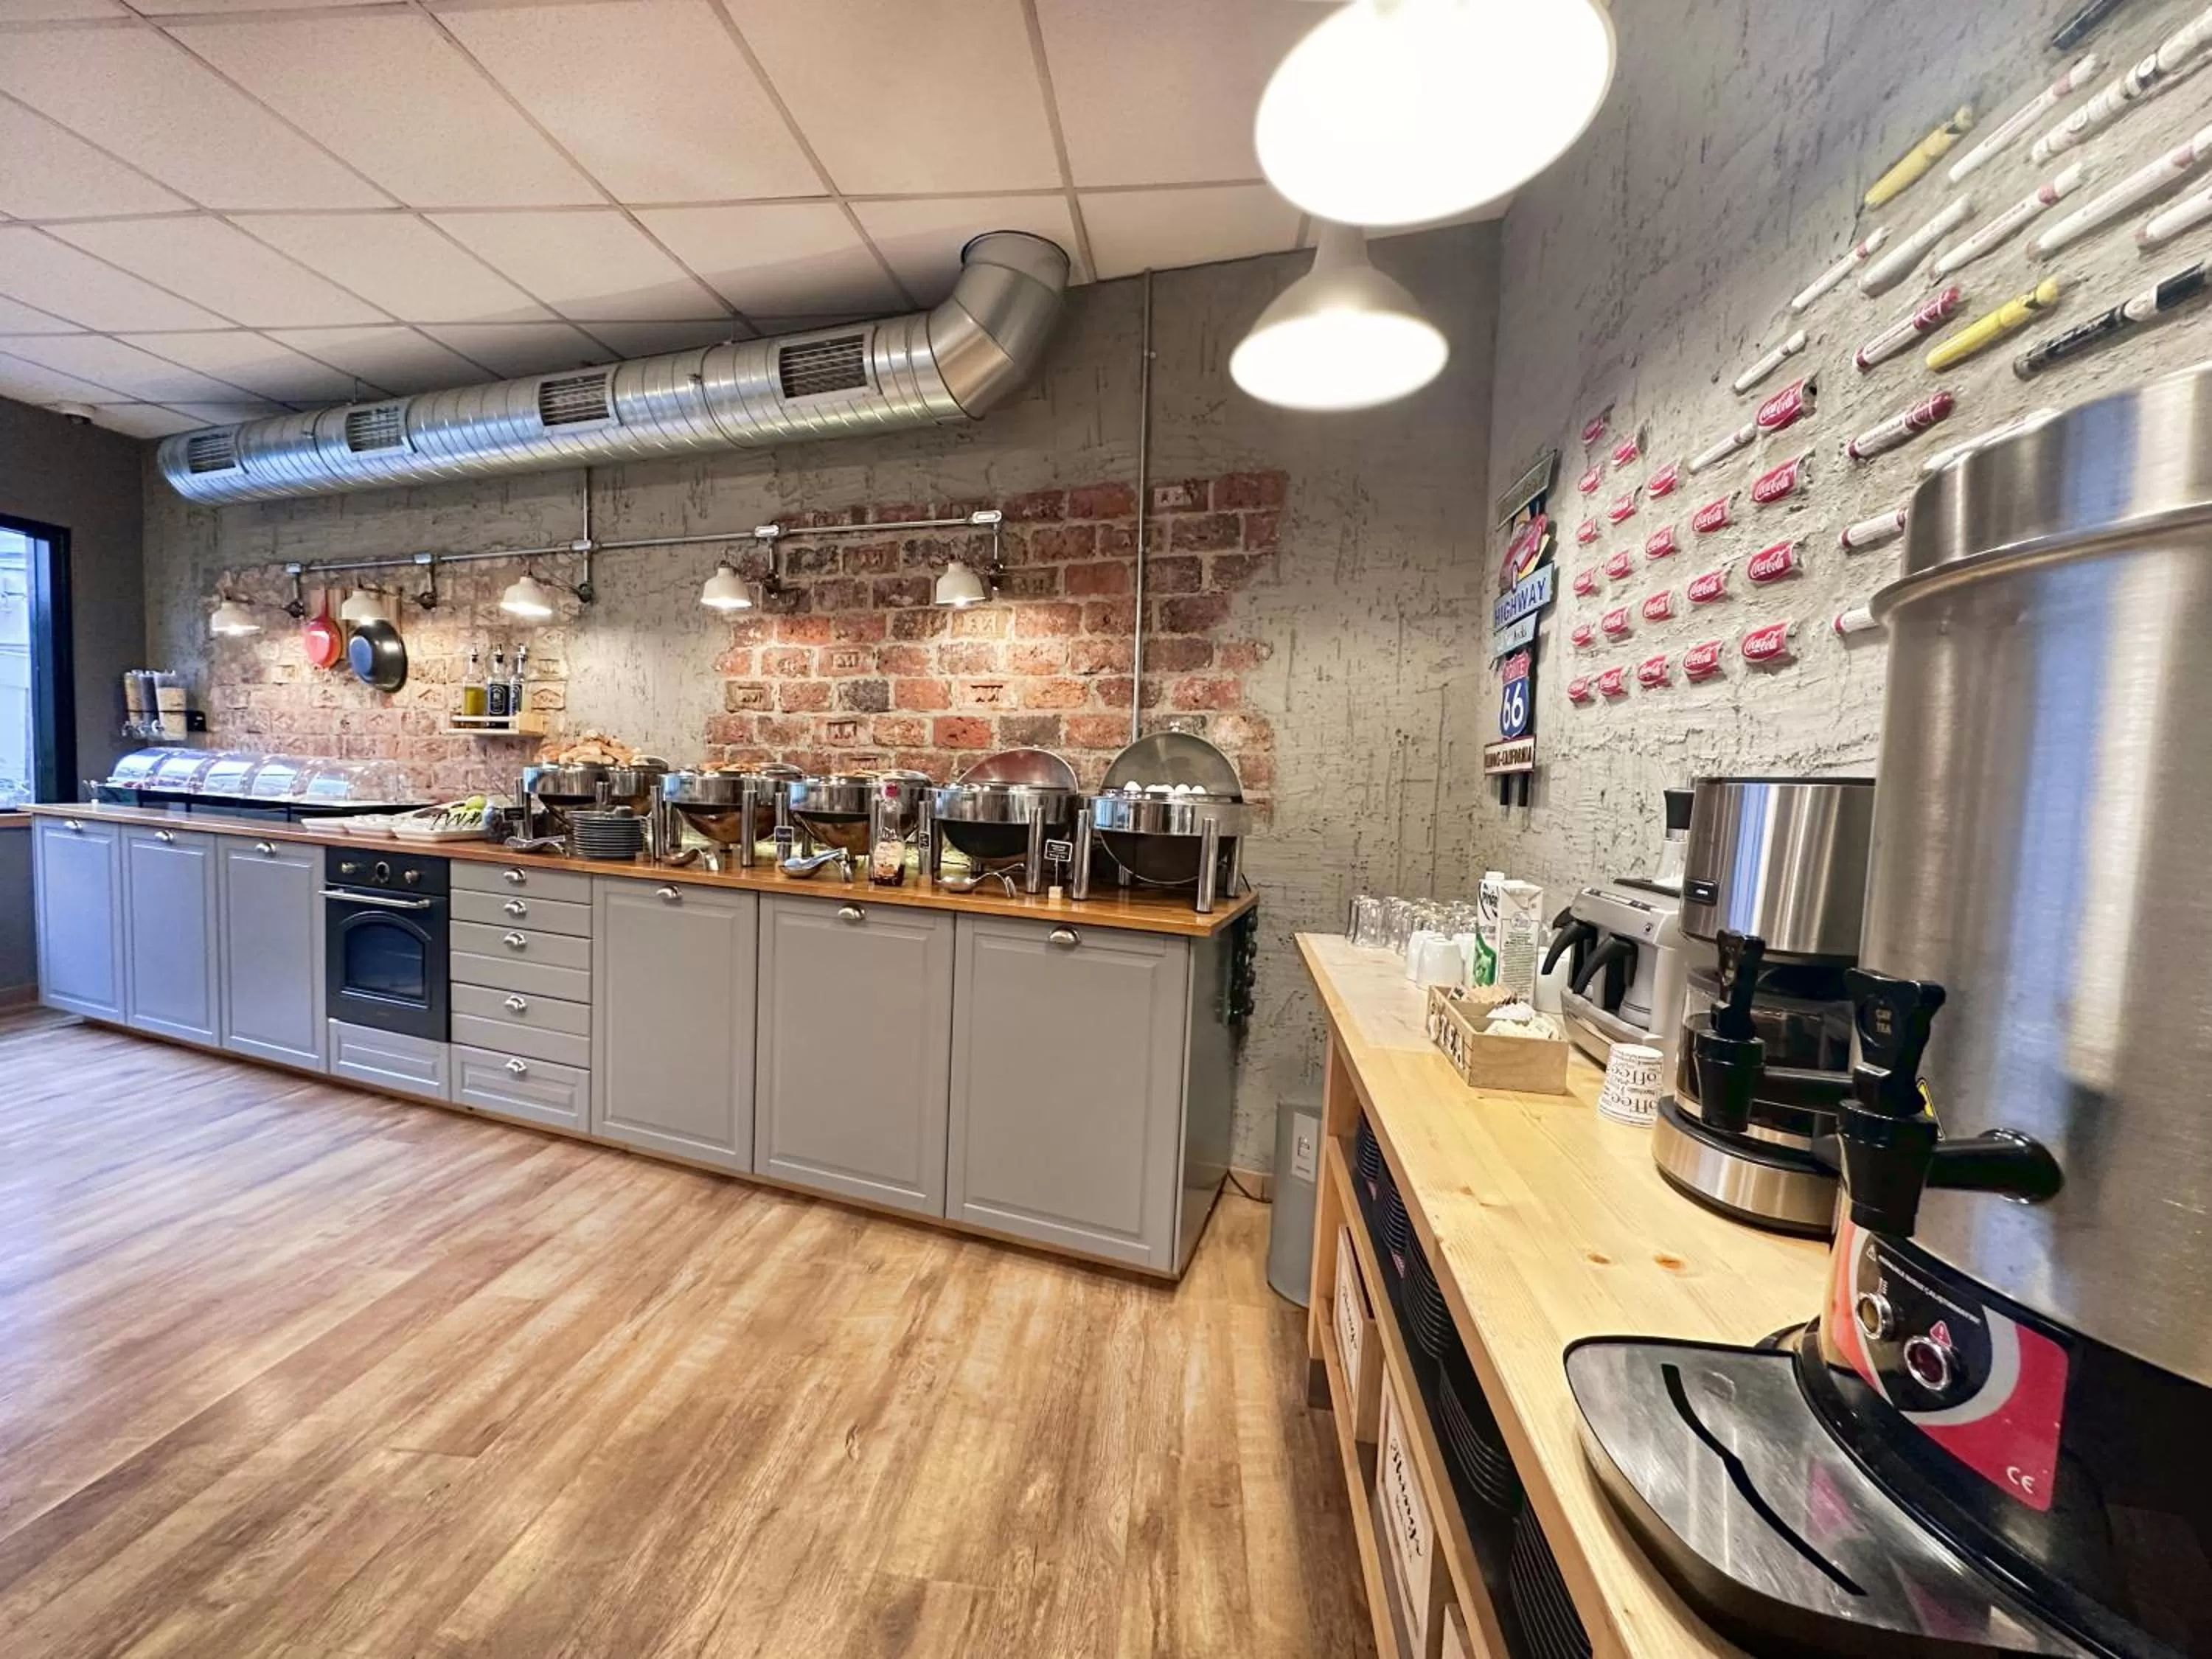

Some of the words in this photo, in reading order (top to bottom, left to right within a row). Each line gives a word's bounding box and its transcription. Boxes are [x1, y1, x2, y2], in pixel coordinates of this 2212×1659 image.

[1494, 577, 1547, 629] HIGHWAY
[1502, 681, 1525, 731] 66
[2006, 1466, 2035, 1494] CE
